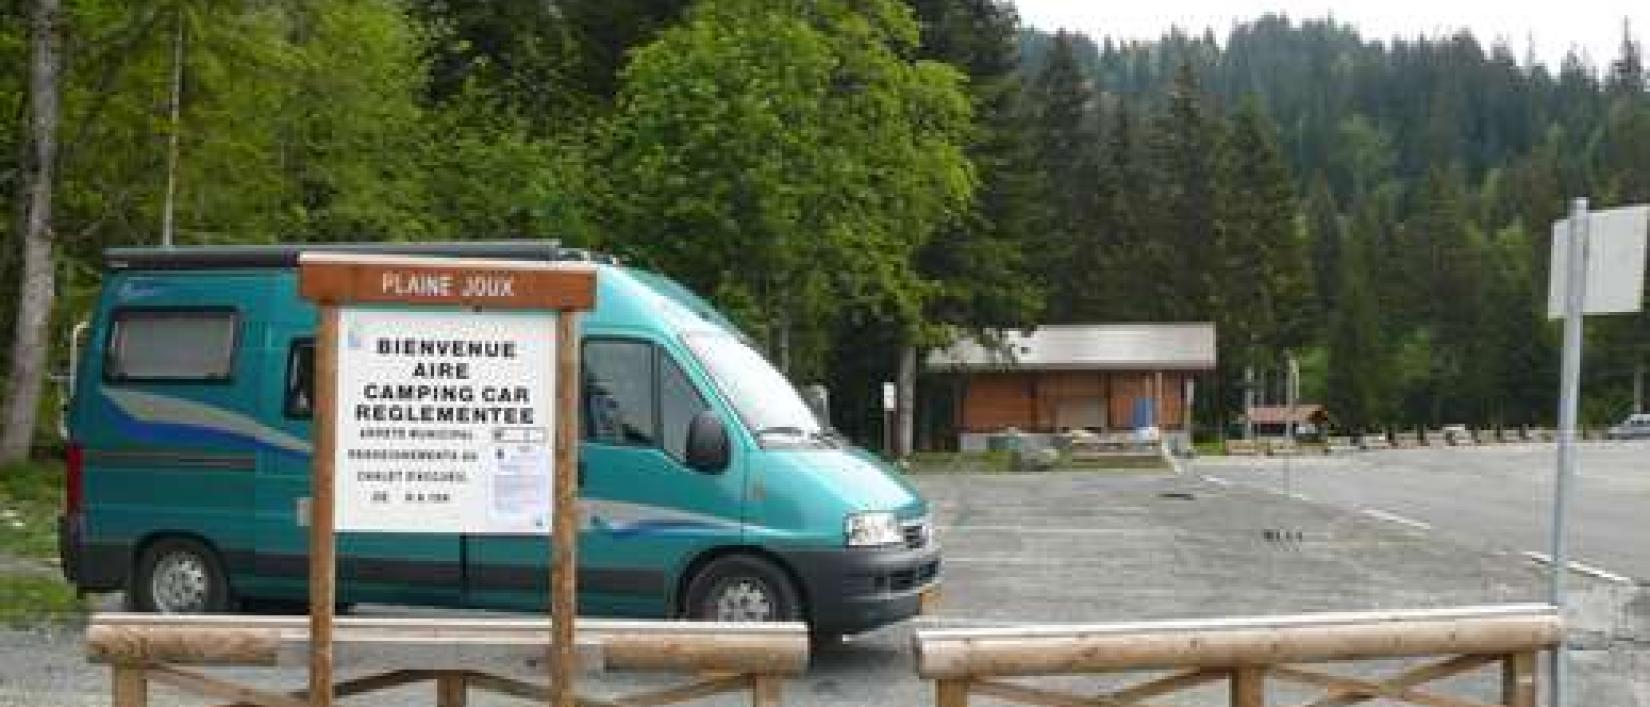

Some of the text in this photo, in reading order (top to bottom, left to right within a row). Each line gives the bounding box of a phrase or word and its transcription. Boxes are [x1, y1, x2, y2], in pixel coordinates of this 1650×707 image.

[382, 272, 515, 297] PLAINE JOUX
[376, 338, 517, 358] BIENVENUE
[412, 362, 469, 380] AIRE
[363, 383, 531, 404] CAMPING CAR
[354, 404, 535, 424] REGLEMENTEE
